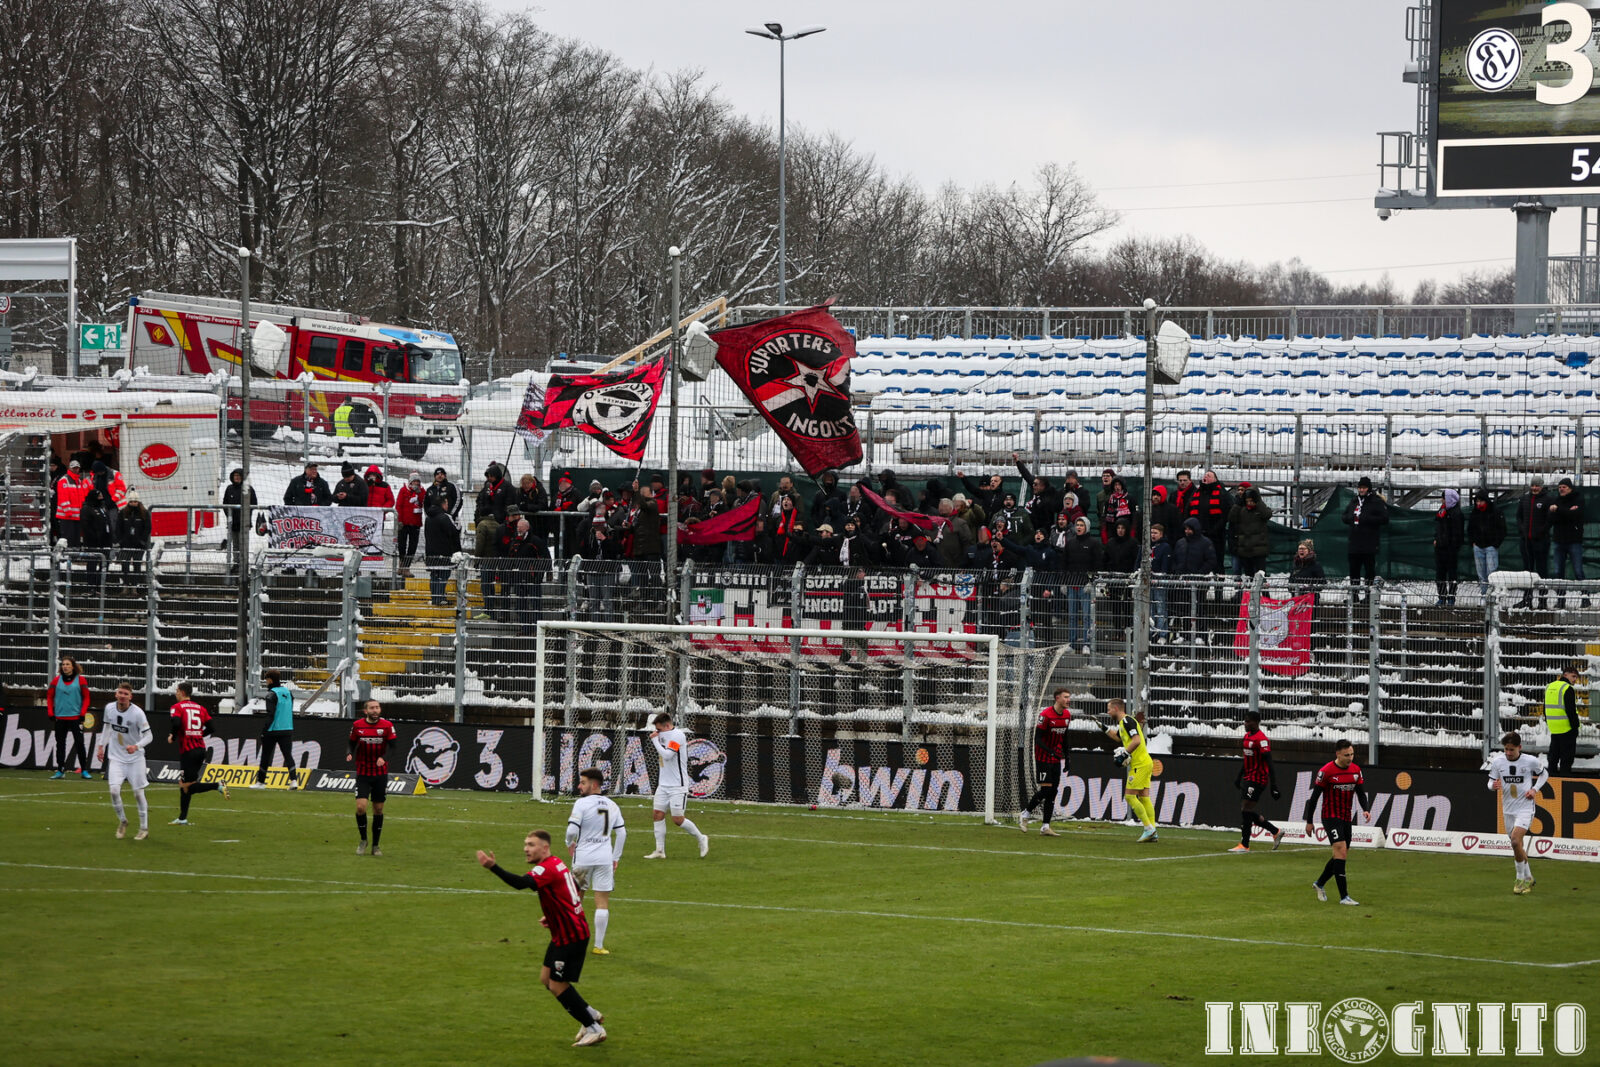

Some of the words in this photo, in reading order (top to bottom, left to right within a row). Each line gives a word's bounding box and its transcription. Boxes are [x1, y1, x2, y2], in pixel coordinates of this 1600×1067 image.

[1536, 2, 1594, 105] 3
[185, 313, 211, 323] Freiwillige
[211, 318, 238, 326] Feuerwehr
[311, 321, 357, 334] www.ziegler.de
[750, 333, 833, 375] SUPORTERS
[273, 517, 322, 535] TORKEL
[805, 574, 898, 590] SUPPTERS
[804, 597, 898, 614] INGOADT
[185, 708, 202, 730] 15
[474, 729, 520, 790] 3.
[316, 773, 356, 790] bwin
[817, 748, 965, 812] bwin
[1040, 772, 1047, 781] 17
[597, 808, 609, 836] 7
[1331, 828, 1339, 840] 3
